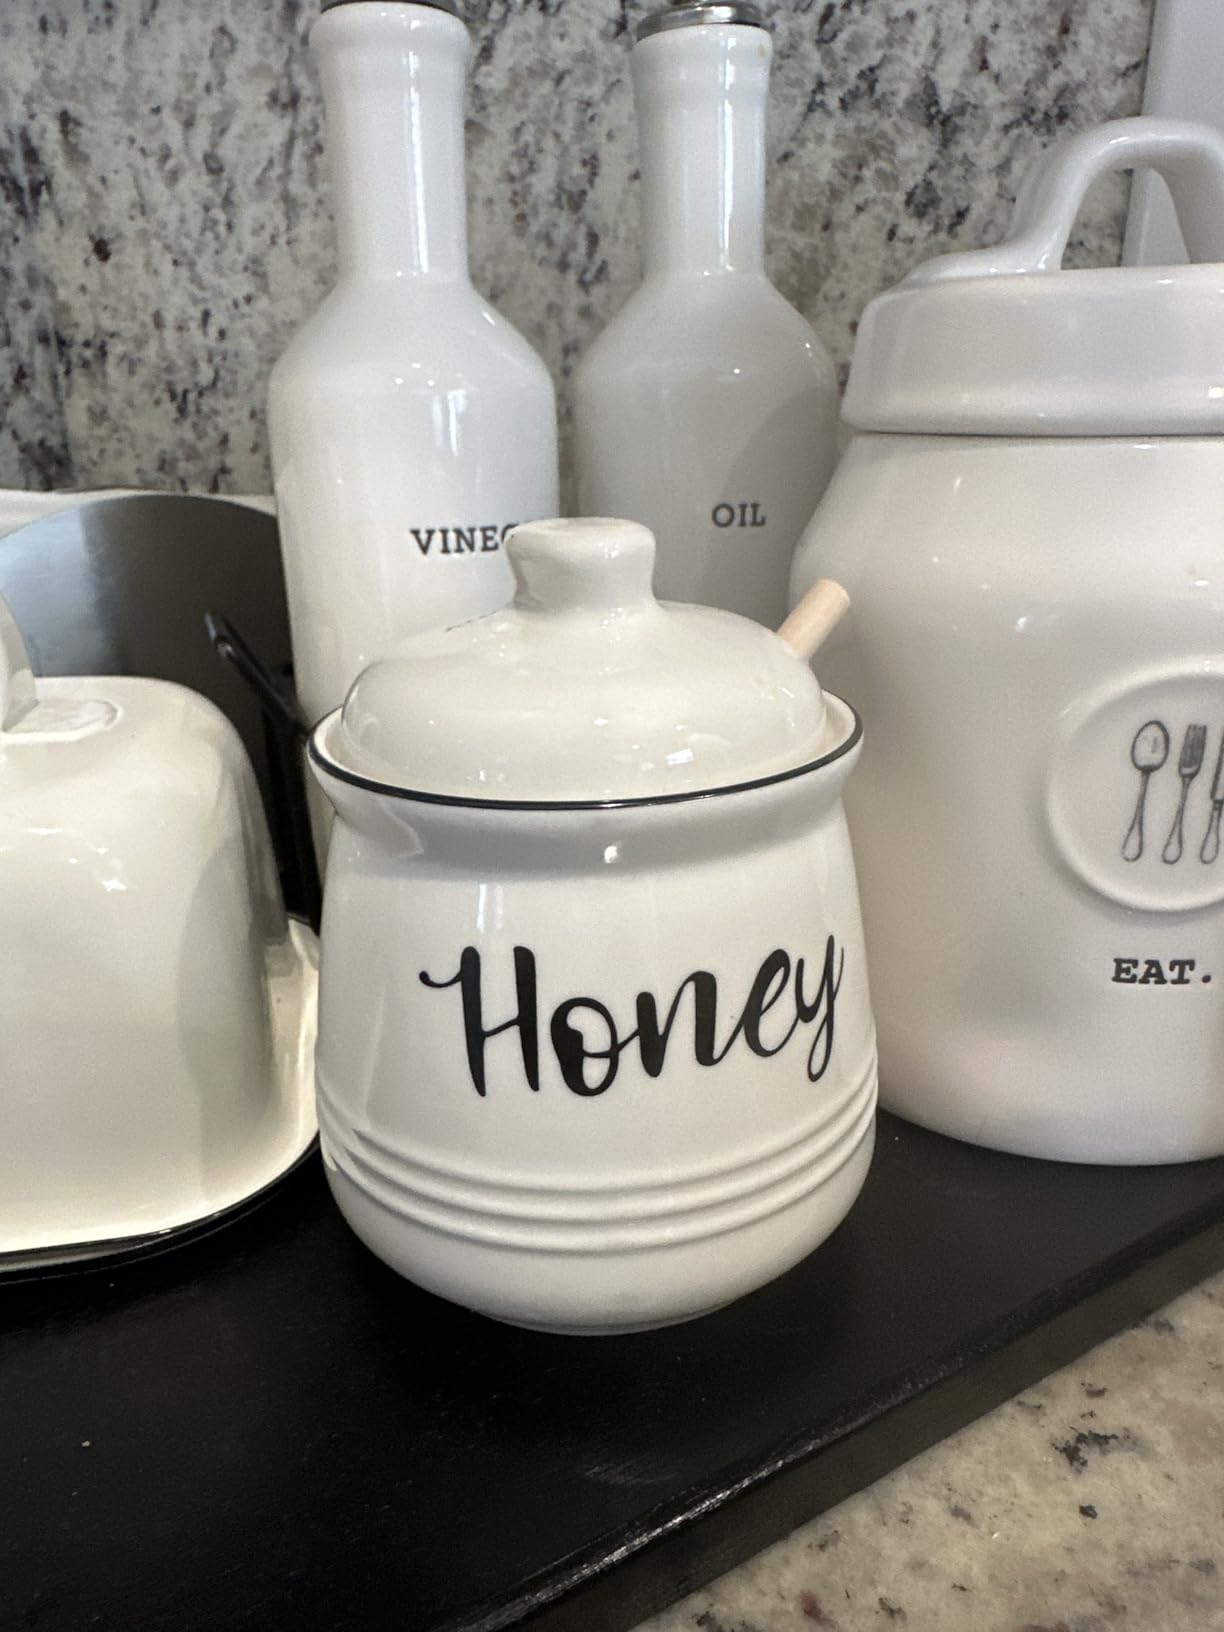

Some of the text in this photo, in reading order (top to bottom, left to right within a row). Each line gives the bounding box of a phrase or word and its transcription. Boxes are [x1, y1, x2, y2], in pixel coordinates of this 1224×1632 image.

[711, 502, 767, 528] OIL
[1111, 958, 1212, 985] EAT.
[419, 935, 845, 1097] Honey
